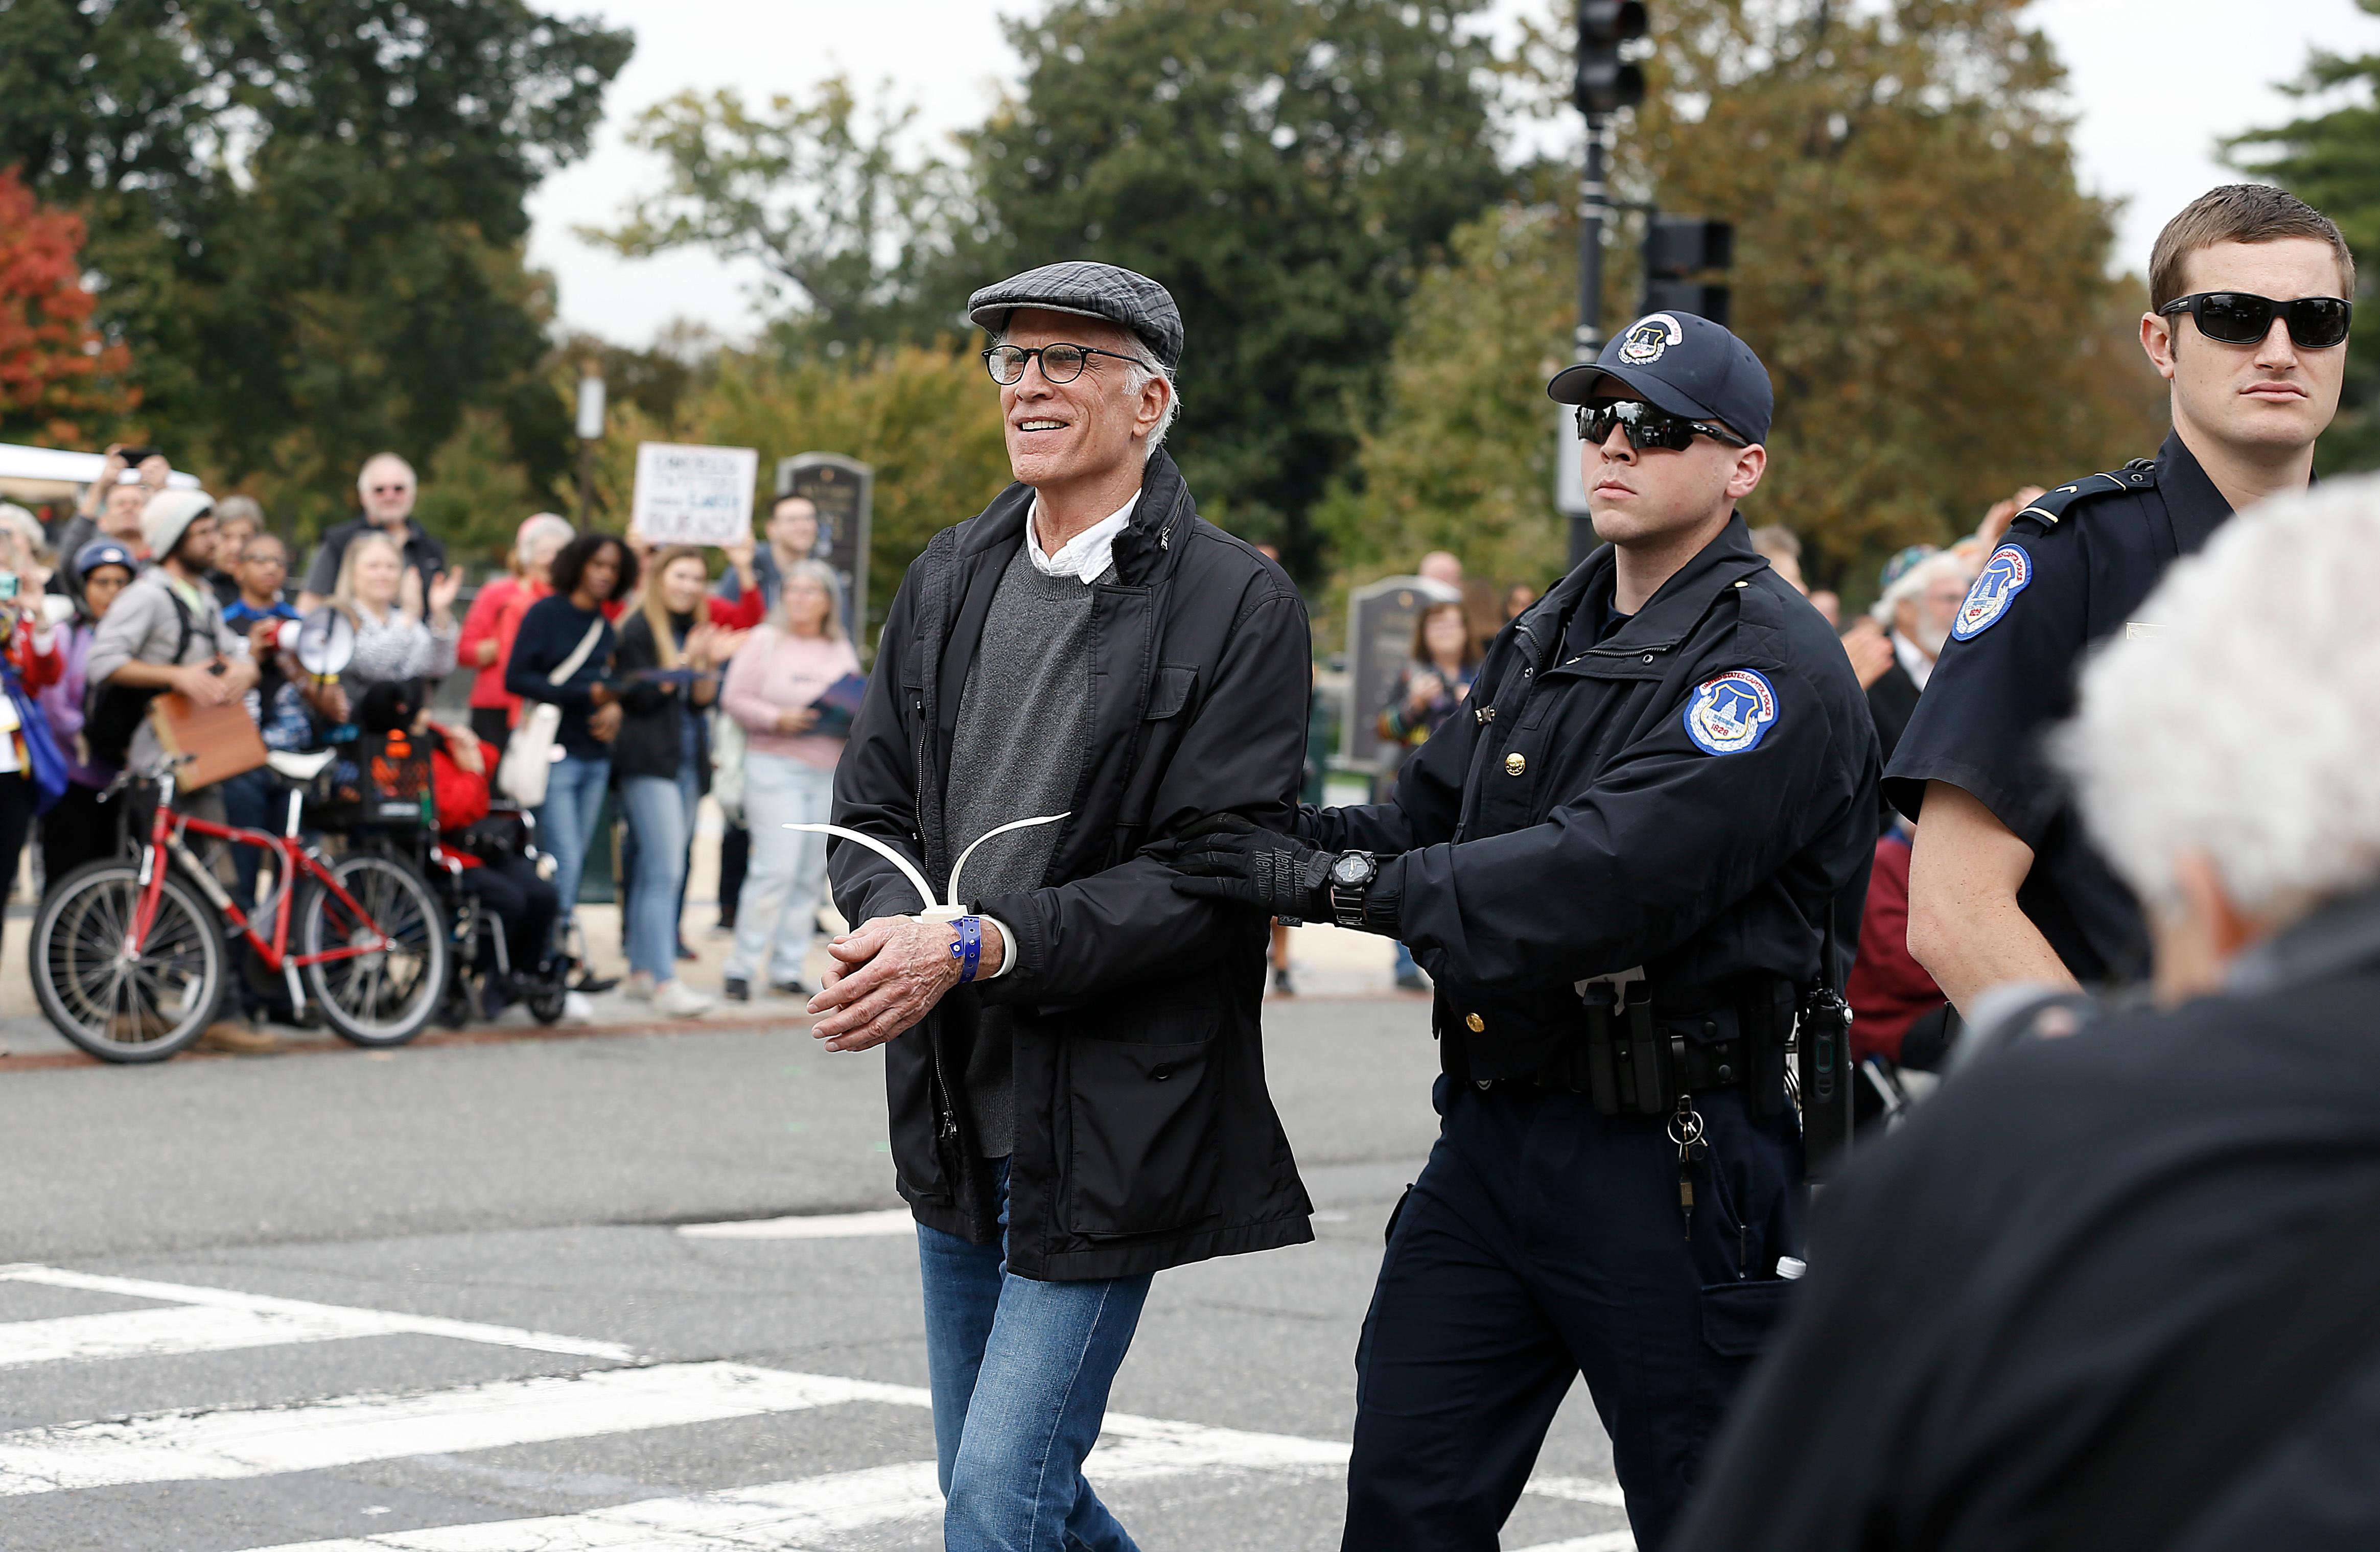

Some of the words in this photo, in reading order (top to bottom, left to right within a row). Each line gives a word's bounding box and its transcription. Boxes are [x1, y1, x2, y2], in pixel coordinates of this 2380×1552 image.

[1701, 674, 1722, 690] UNITED
[1745, 675, 1765, 697] CAPITOL
[1711, 723, 1729, 736] 1828
[1275, 846, 1293, 898] Mechanix
